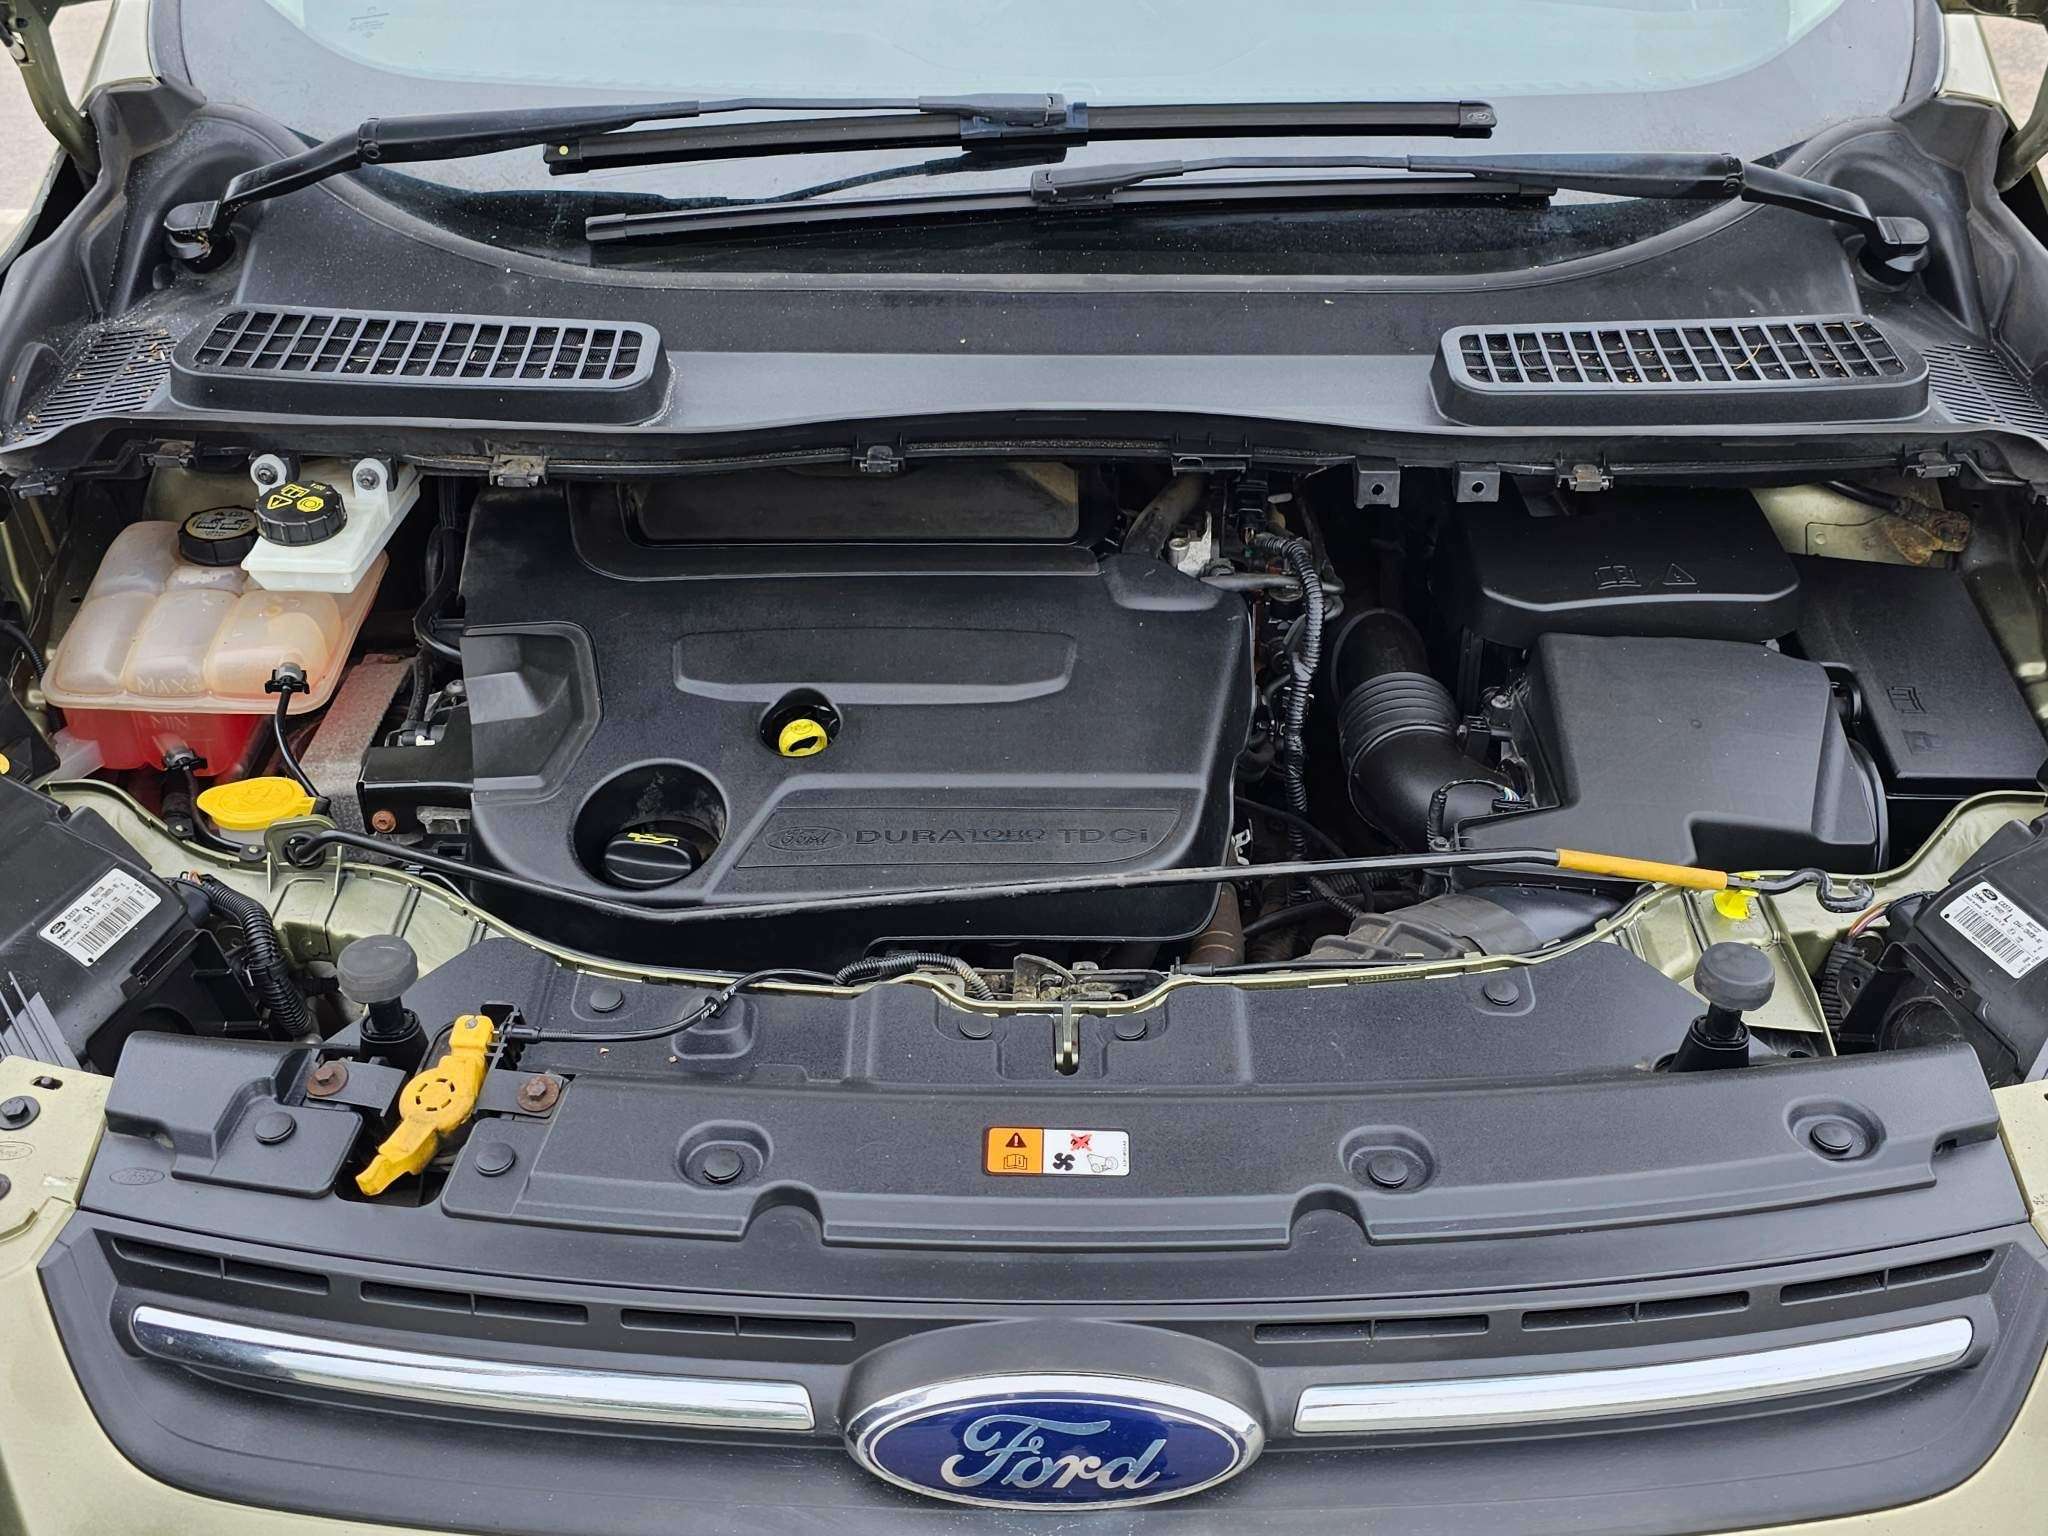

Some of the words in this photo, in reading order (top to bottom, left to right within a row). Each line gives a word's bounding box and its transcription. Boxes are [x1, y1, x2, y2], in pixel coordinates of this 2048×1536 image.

[1057, 828, 1148, 844] TDCi
[82, 905, 96, 915] R
[940, 1414, 1168, 1490] Ford
